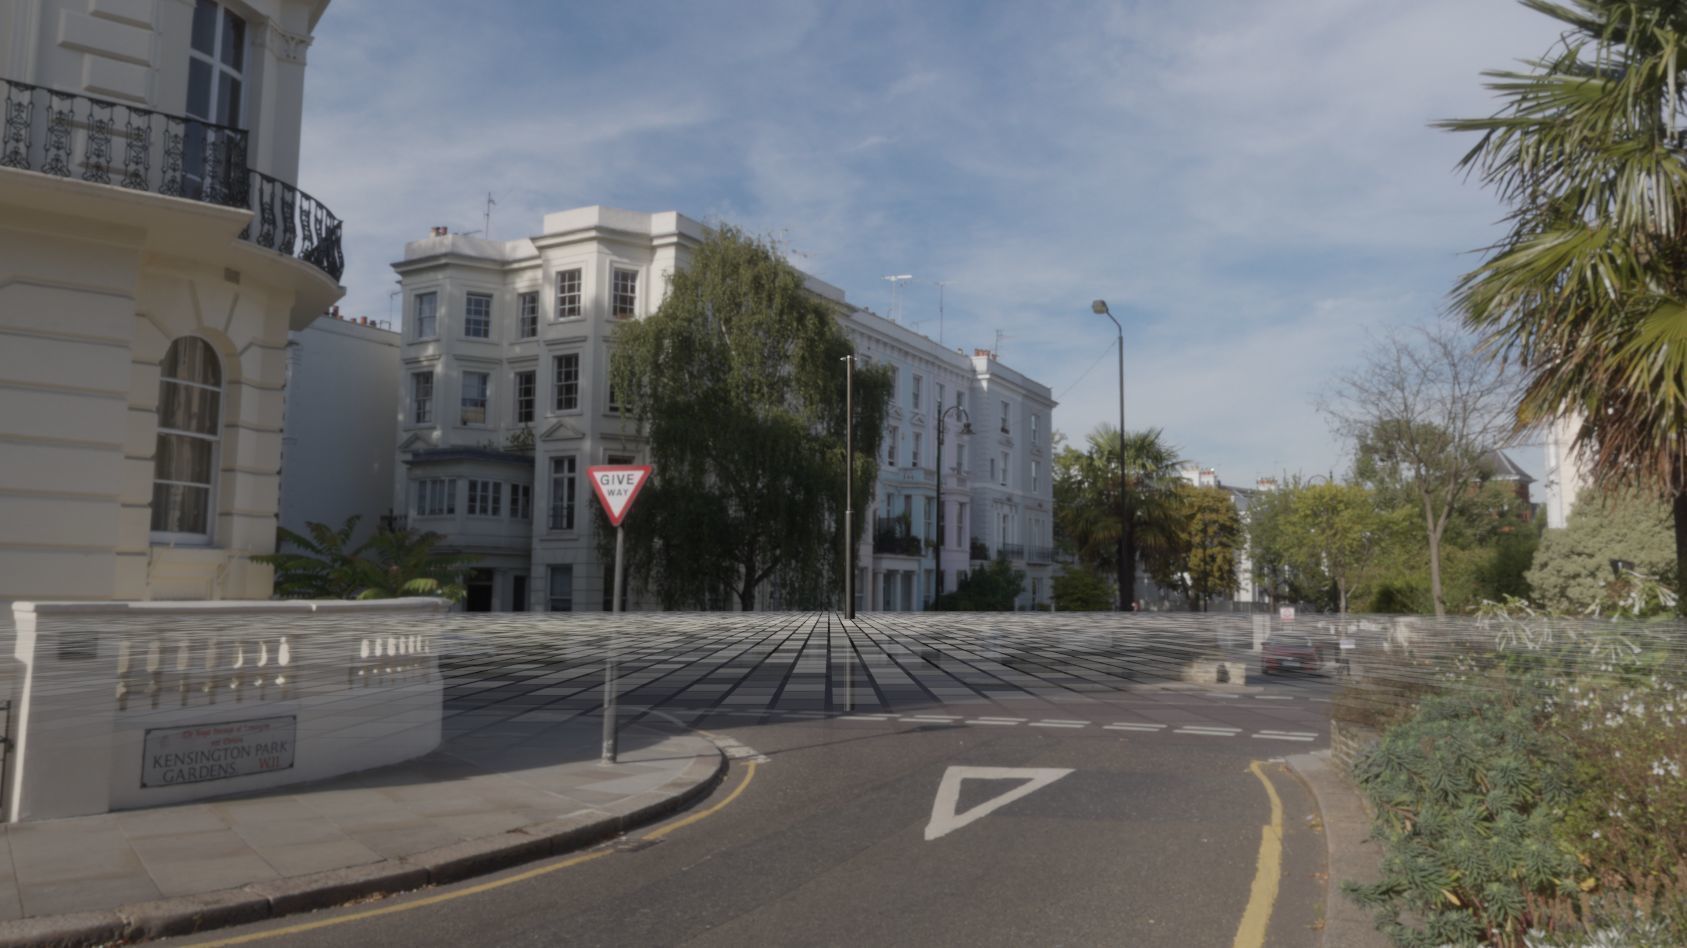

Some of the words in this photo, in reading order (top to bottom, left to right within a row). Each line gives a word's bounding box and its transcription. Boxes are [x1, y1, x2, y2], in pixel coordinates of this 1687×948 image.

[600, 473, 635, 485] GIVE
[607, 489, 629, 497] WAY
[153, 745, 252, 769] KENSINGTON
[255, 740, 288, 757] PARK
